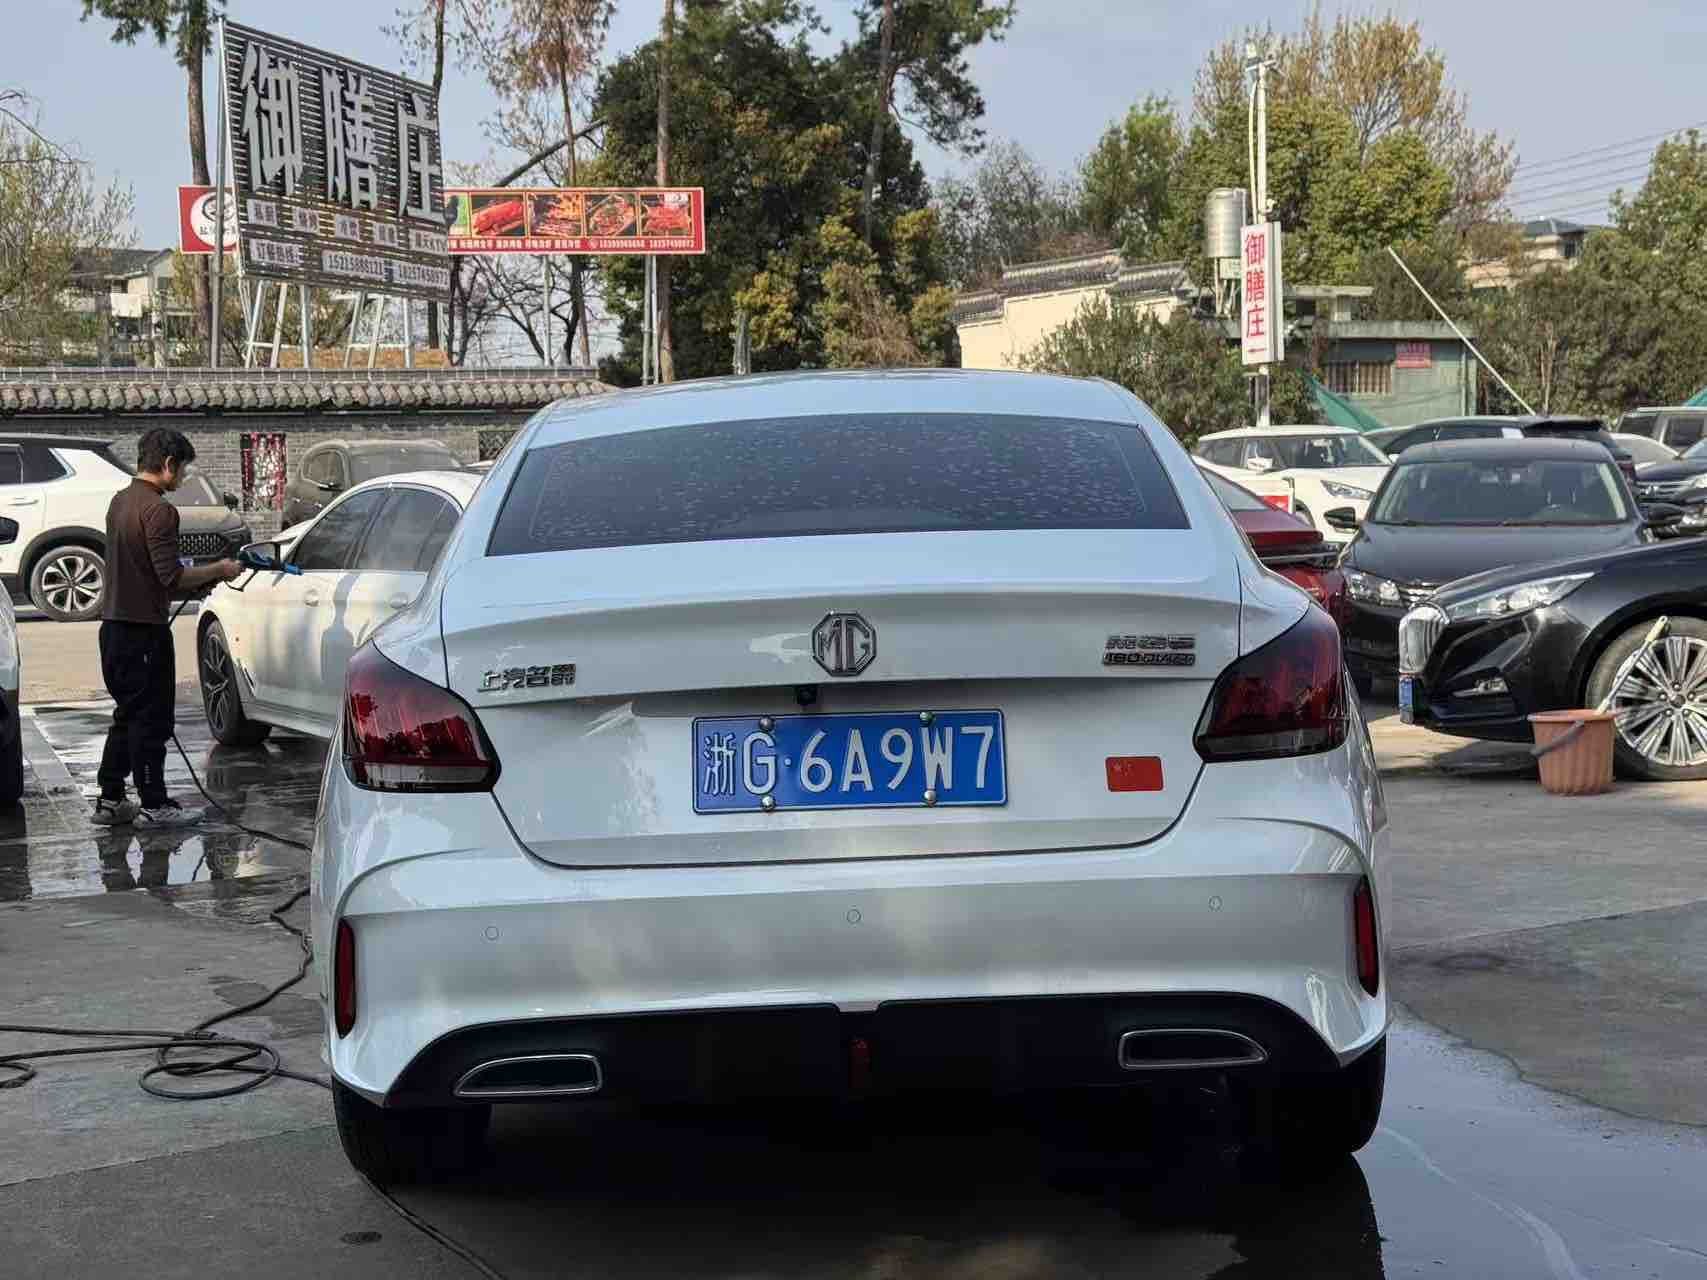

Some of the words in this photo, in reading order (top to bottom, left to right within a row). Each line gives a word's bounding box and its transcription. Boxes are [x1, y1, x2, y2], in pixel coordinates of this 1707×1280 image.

[240, 40, 447, 223] 御膳庄
[1245, 233, 1265, 338] 御膳庄
[478, 663, 576, 693] 上汽名爵
[814, 613, 875, 676] MG
[703, 726, 995, 797] 浙G·6A9W7
